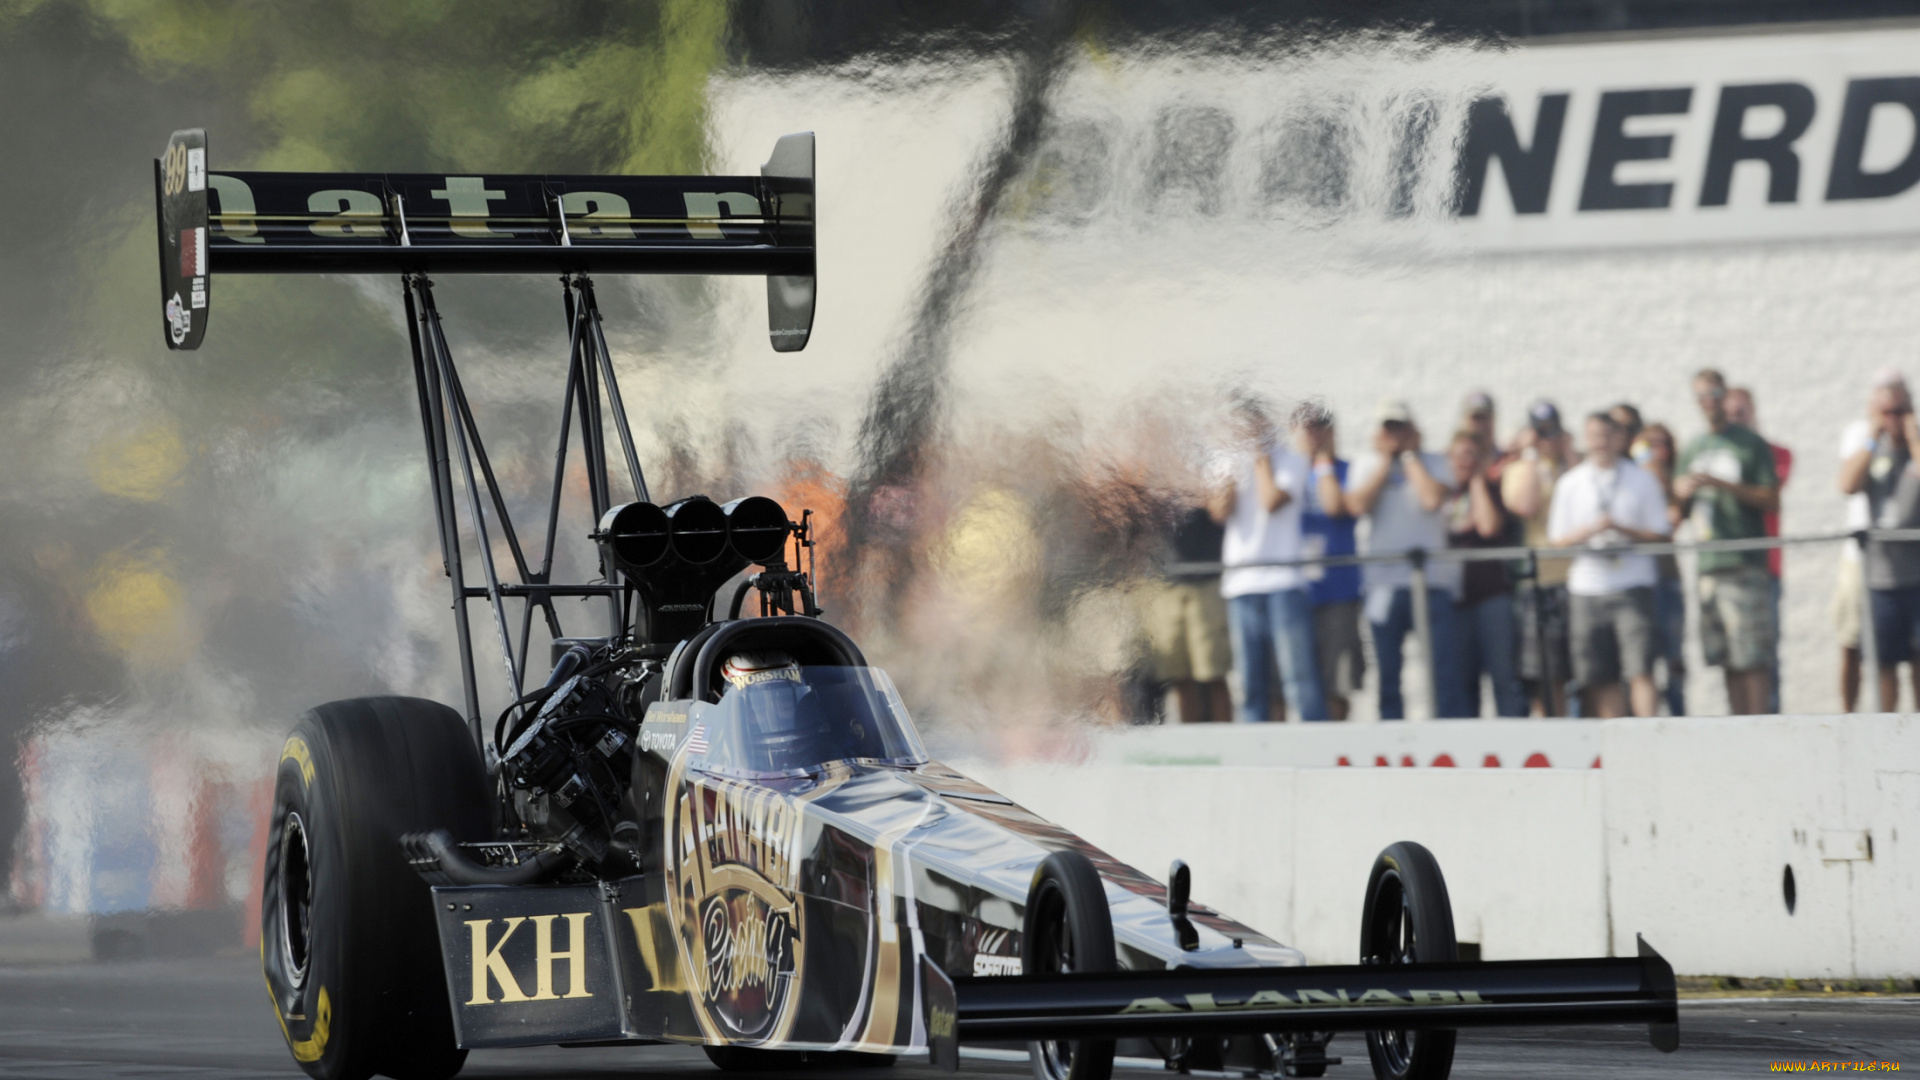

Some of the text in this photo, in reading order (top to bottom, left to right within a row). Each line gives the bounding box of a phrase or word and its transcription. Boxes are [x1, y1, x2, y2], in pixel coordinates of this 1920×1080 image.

[730, 669, 802, 691] WORSHAM
[651, 733, 676, 750] TOYOTA
[464, 911, 593, 1006] KH
